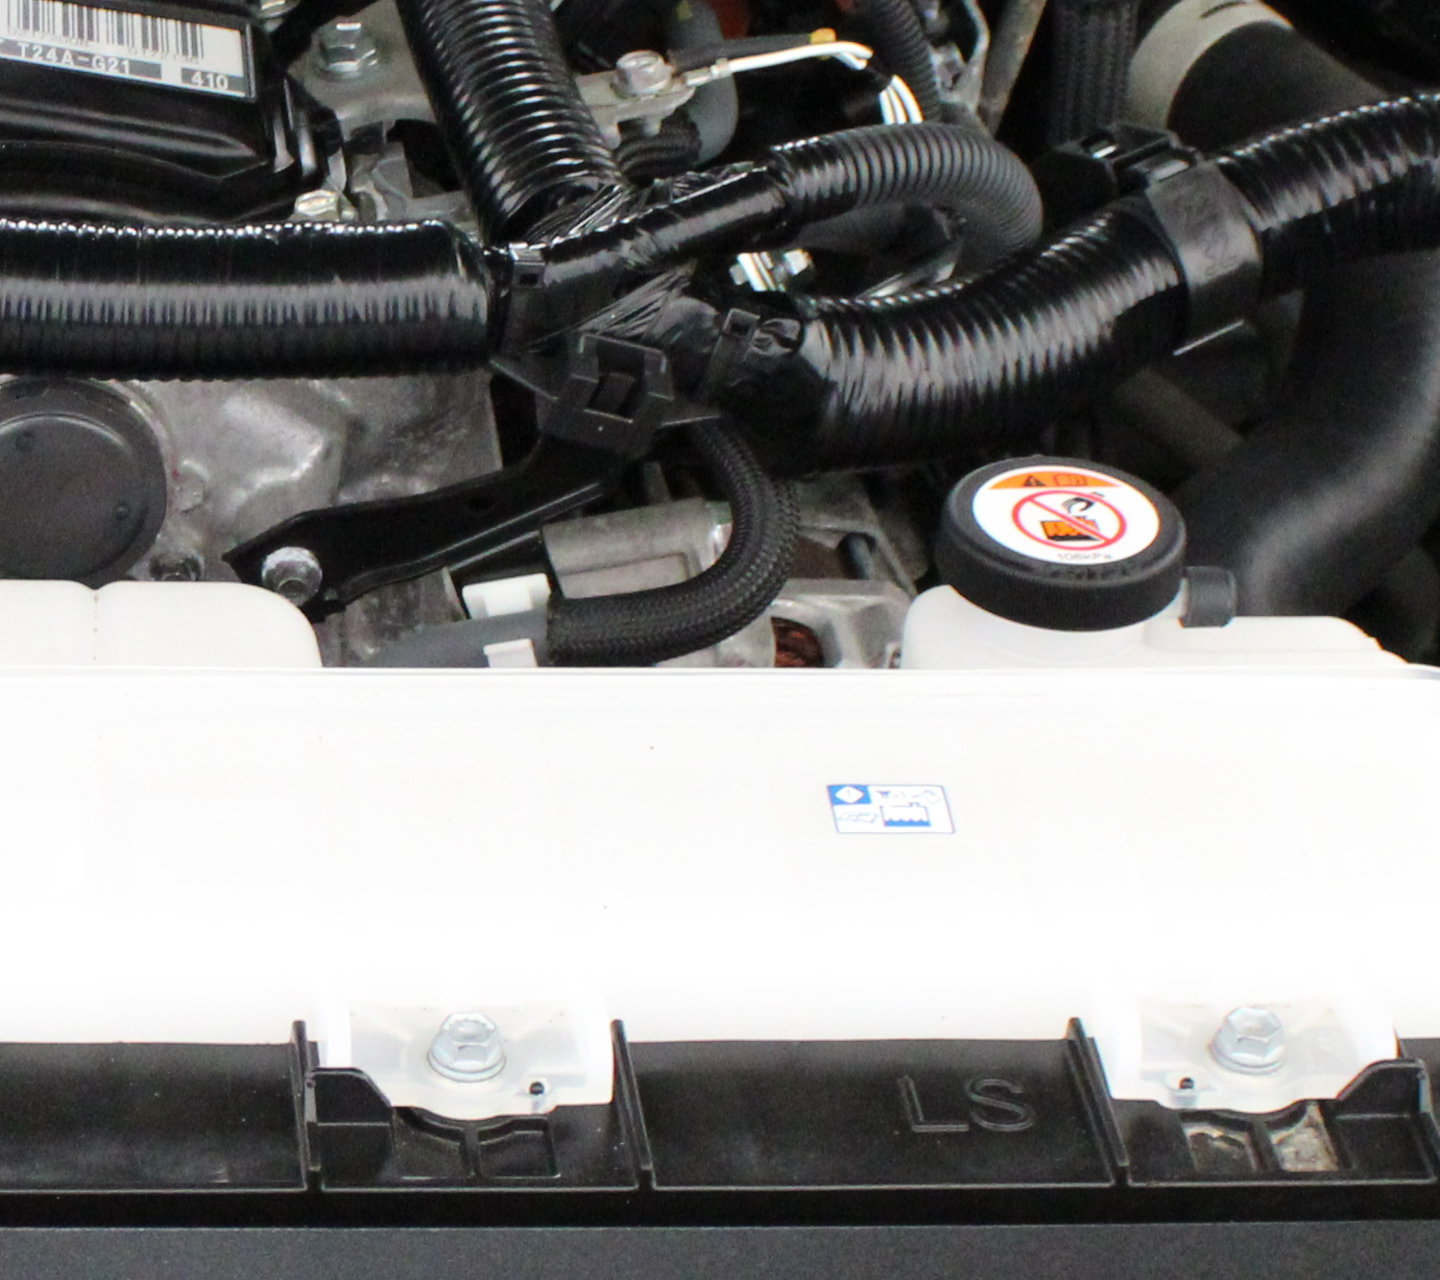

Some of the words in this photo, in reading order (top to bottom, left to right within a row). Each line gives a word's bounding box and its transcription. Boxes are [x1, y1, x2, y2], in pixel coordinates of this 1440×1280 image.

[18, 41, 131, 75] T24A-G21
[191, 73, 229, 90] 410
[897, 1074, 1036, 1133] LS
